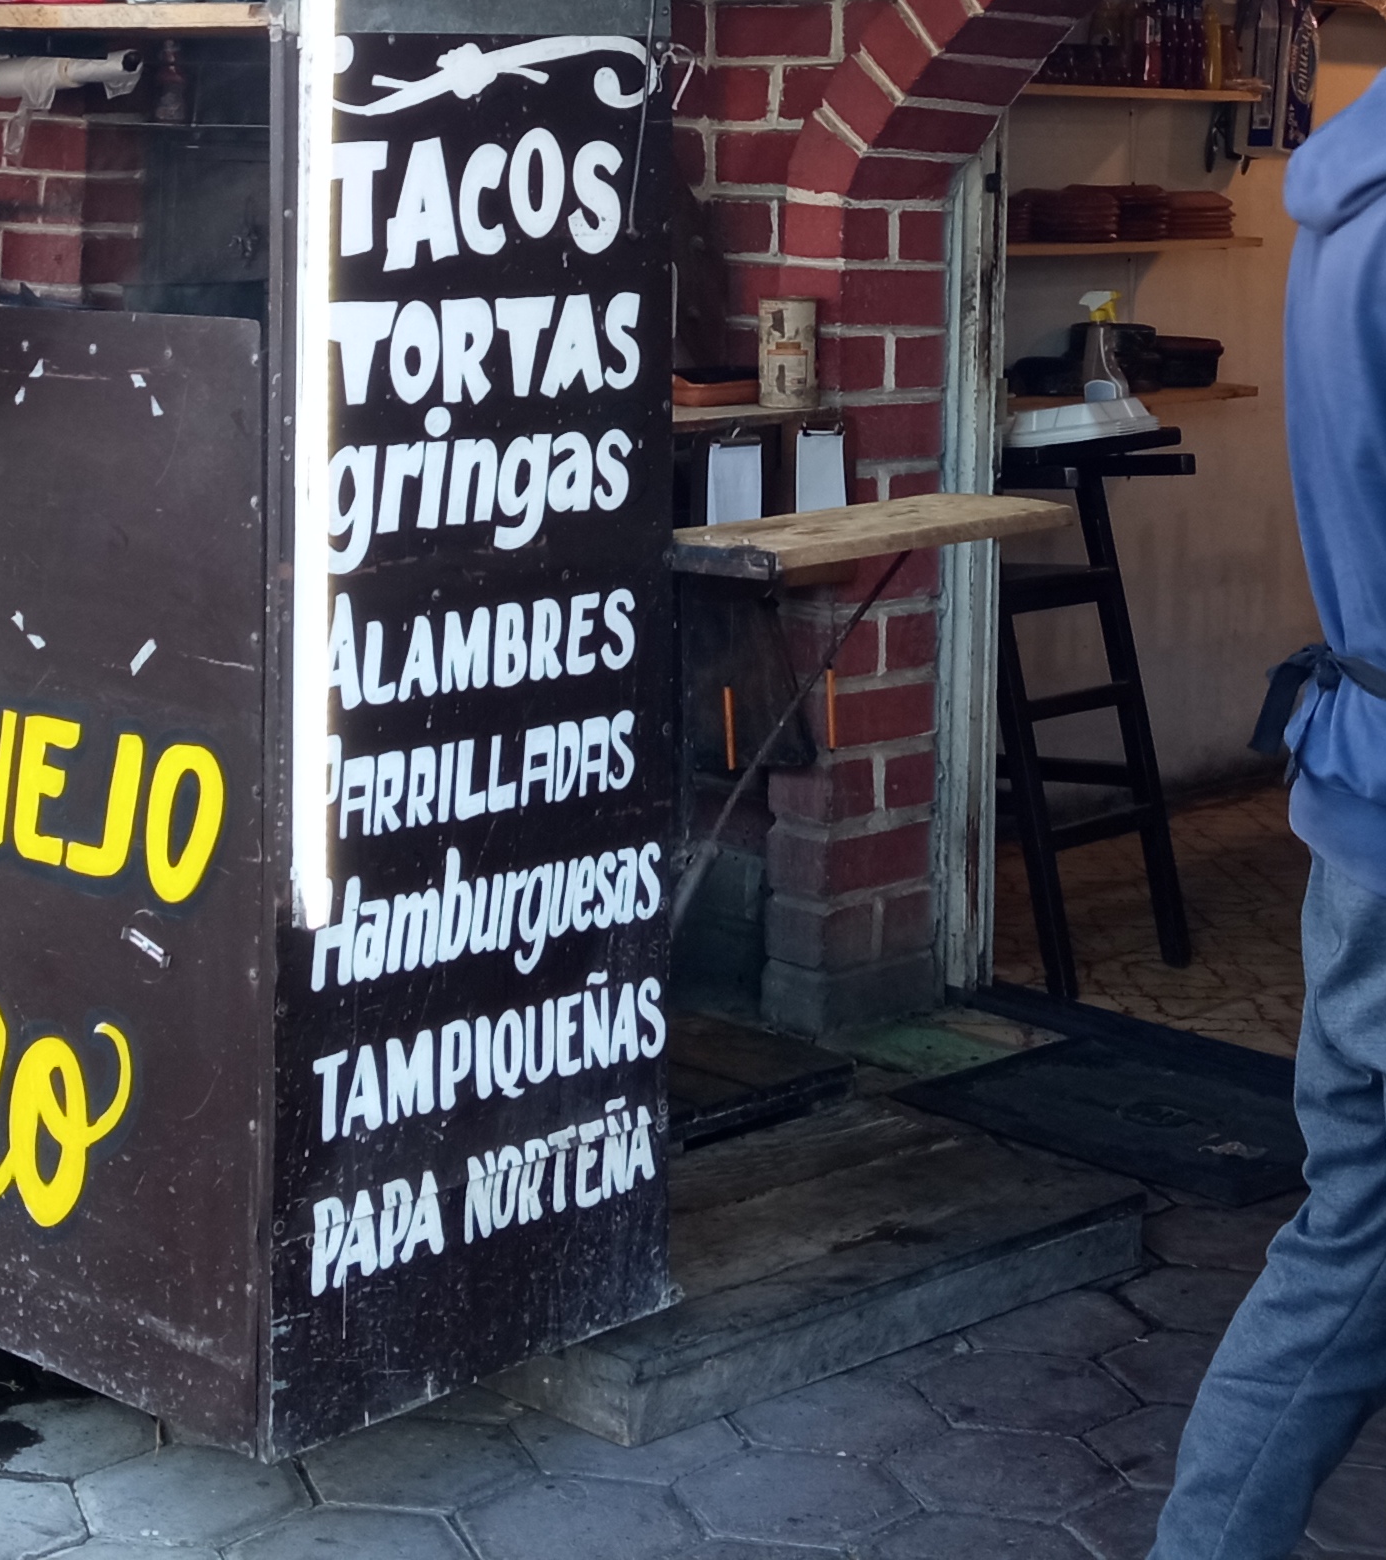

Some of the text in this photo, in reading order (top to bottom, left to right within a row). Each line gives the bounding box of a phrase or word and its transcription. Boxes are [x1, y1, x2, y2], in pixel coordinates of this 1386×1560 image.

[1297, 21, 1314, 97] Premier
[331, 127, 624, 272] TACOS
[328, 291, 641, 406] TORTAS
[328, 407, 634, 576] gringas
[327, 588, 636, 710] ALAMBRES
[311, 841, 663, 993] Hamburguesas
[313, 970, 668, 1143] TAMPIQUEÑAS
[311, 1096, 655, 1297] PAPA NORTEÑA
